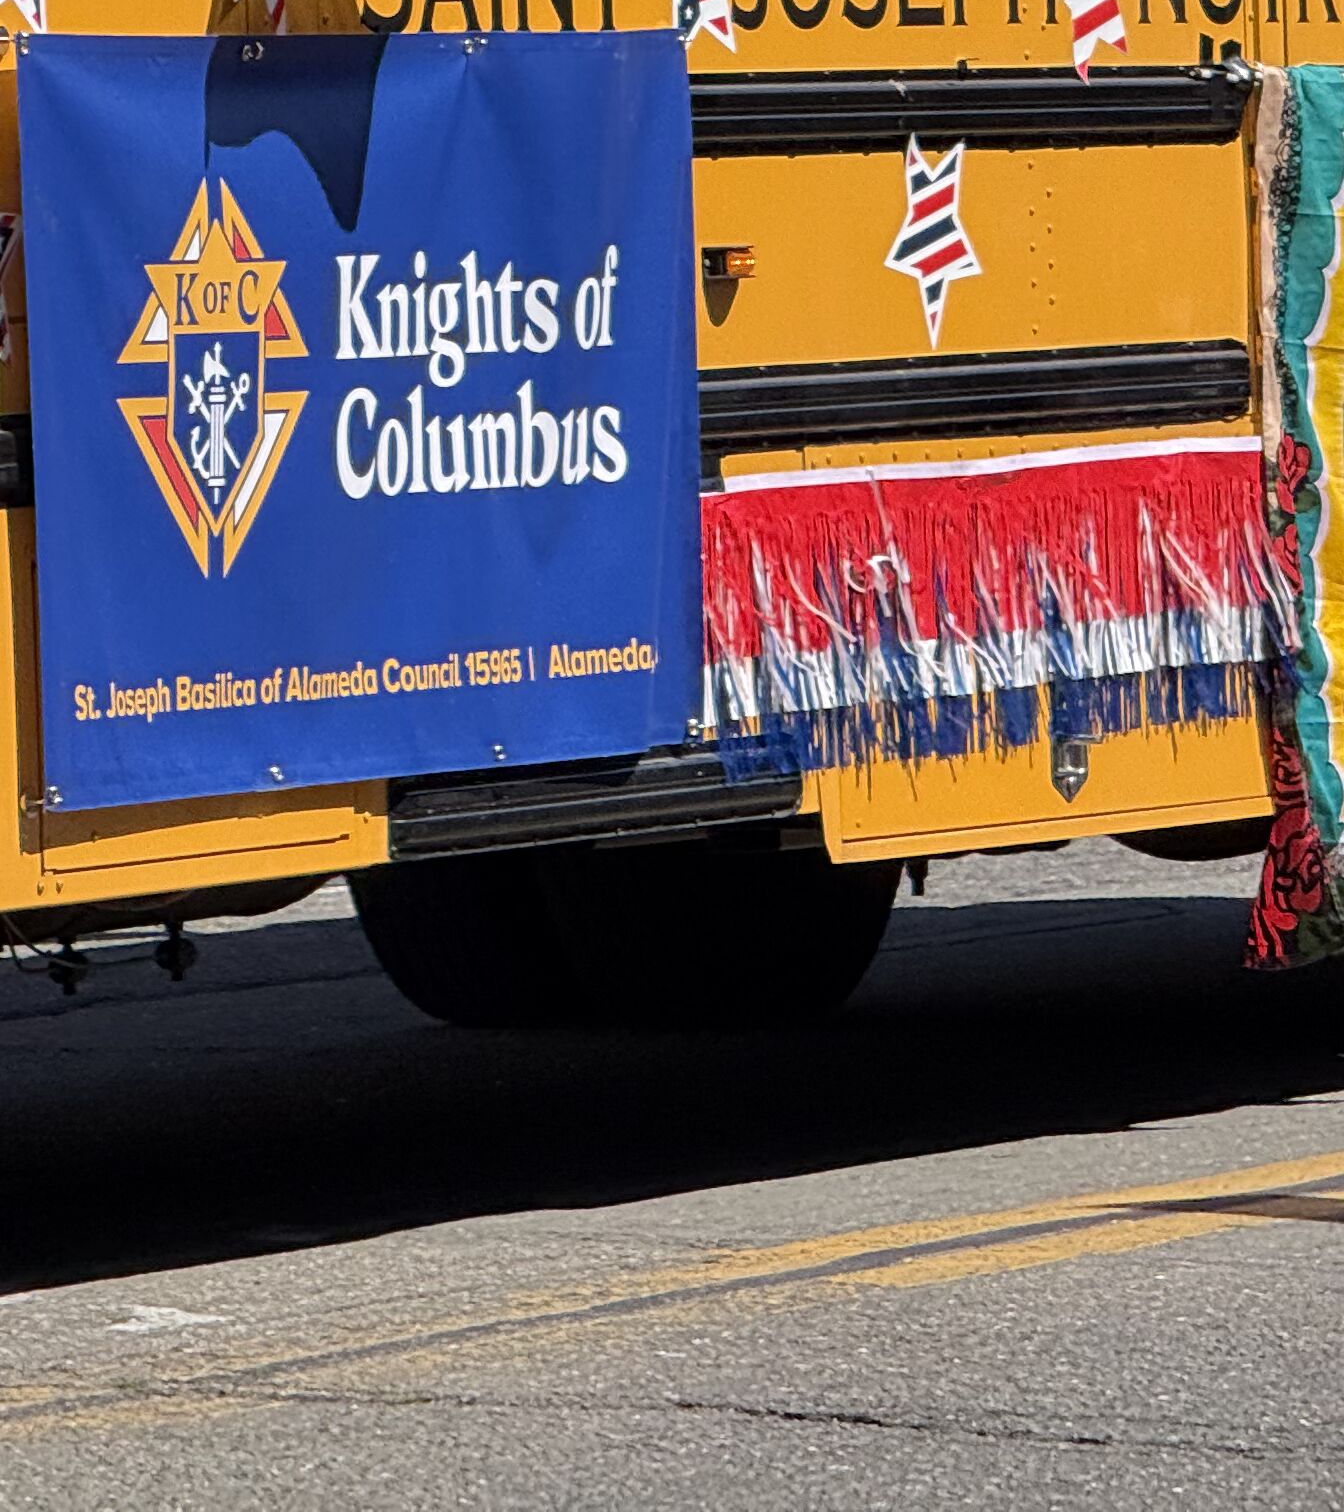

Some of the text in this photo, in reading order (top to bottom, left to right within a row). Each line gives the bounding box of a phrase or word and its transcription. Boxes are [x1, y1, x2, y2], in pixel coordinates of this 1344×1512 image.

[173, 272, 200, 325] K
[237, 269, 260, 325] C
[335, 244, 618, 388] Knights of
[335, 379, 628, 500] Columbus
[74, 684, 102, 721] St.
[106, 677, 171, 723] Joseph
[176, 671, 256, 712] Basilica
[261, 667, 284, 705] of
[284, 660, 379, 703] Alameda
[382, 653, 462, 694] Council
[465, 648, 522, 687] 15965
